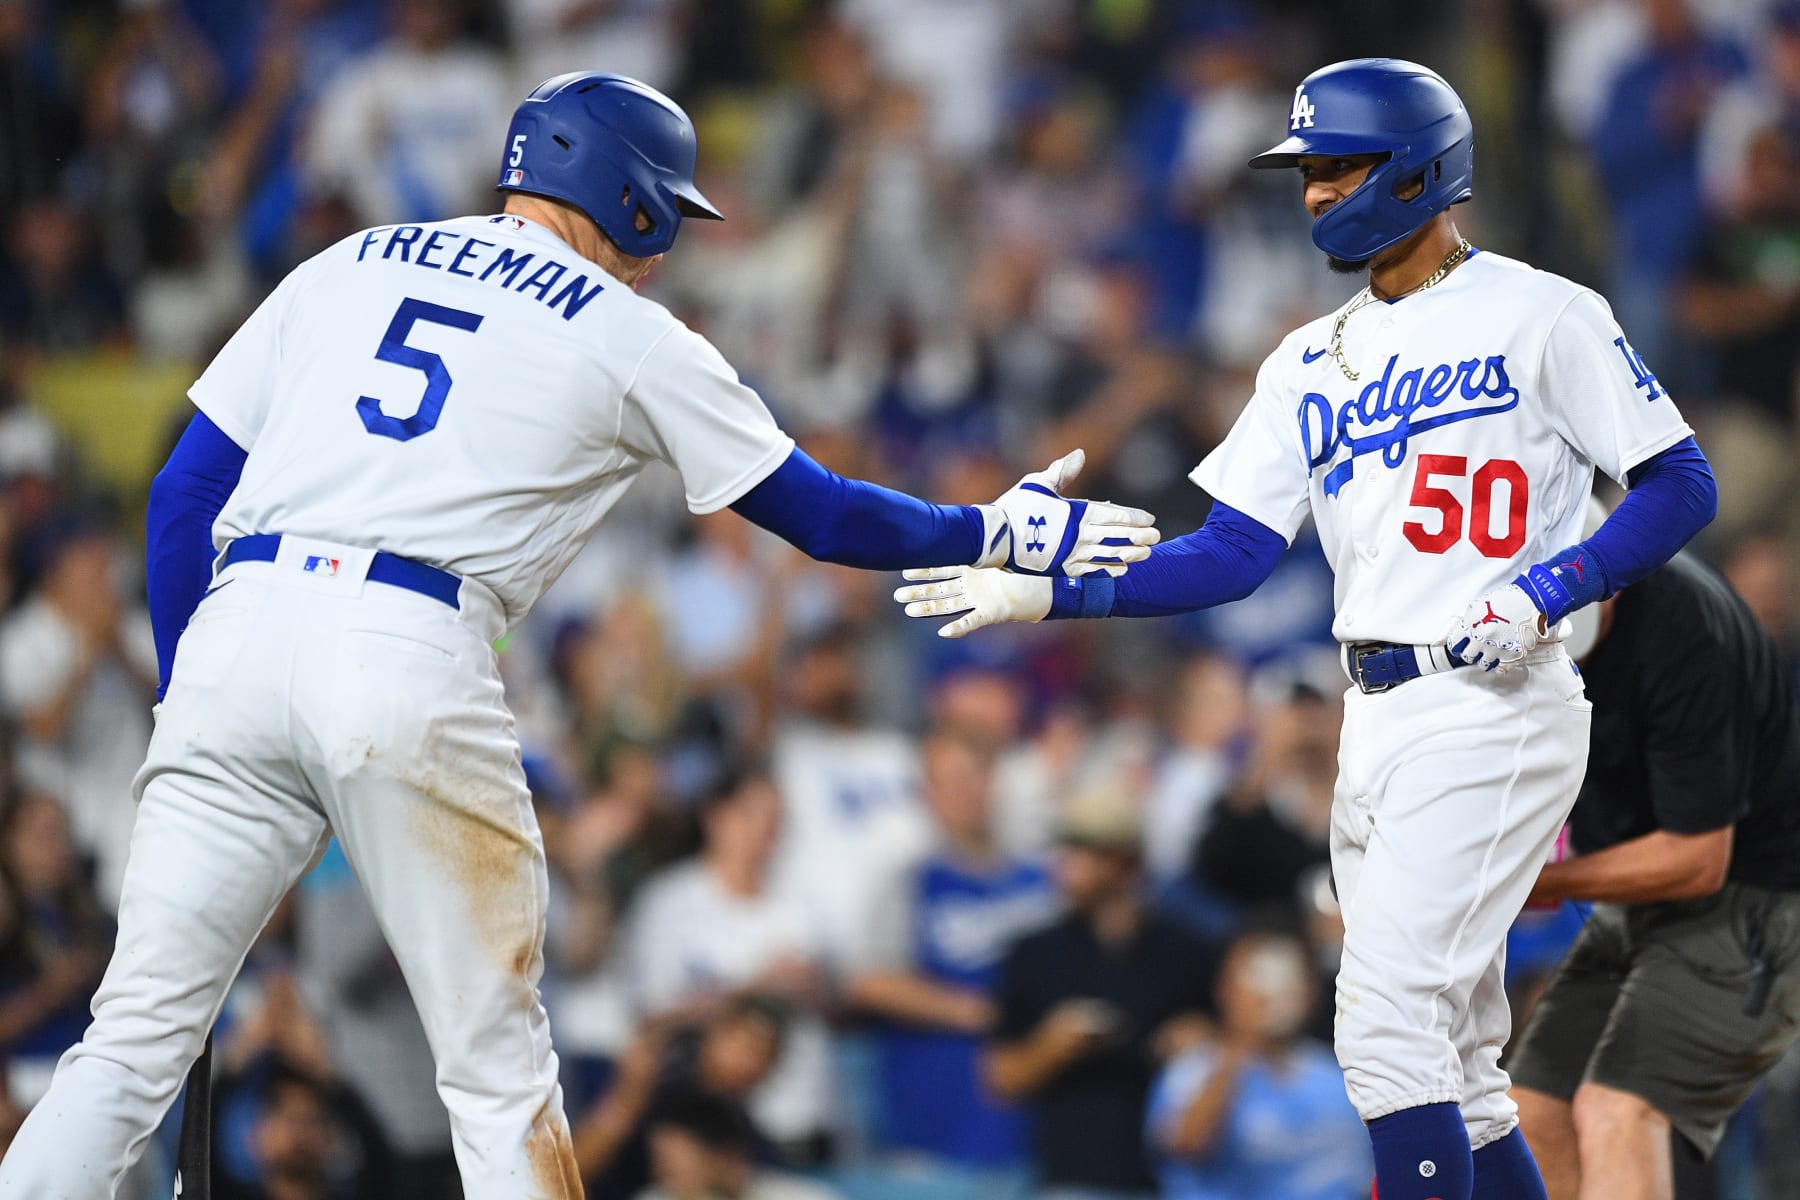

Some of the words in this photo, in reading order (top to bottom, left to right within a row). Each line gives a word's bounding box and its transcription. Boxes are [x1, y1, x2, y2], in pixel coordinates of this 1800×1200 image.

[509, 135, 527, 167] 5
[1291, 85, 1315, 130] LA
[357, 227, 605, 321] FREEMAN
[355, 297, 485, 442] 5
[1298, 353, 1518, 482] Dodgers
[1403, 454, 1528, 558] 50
